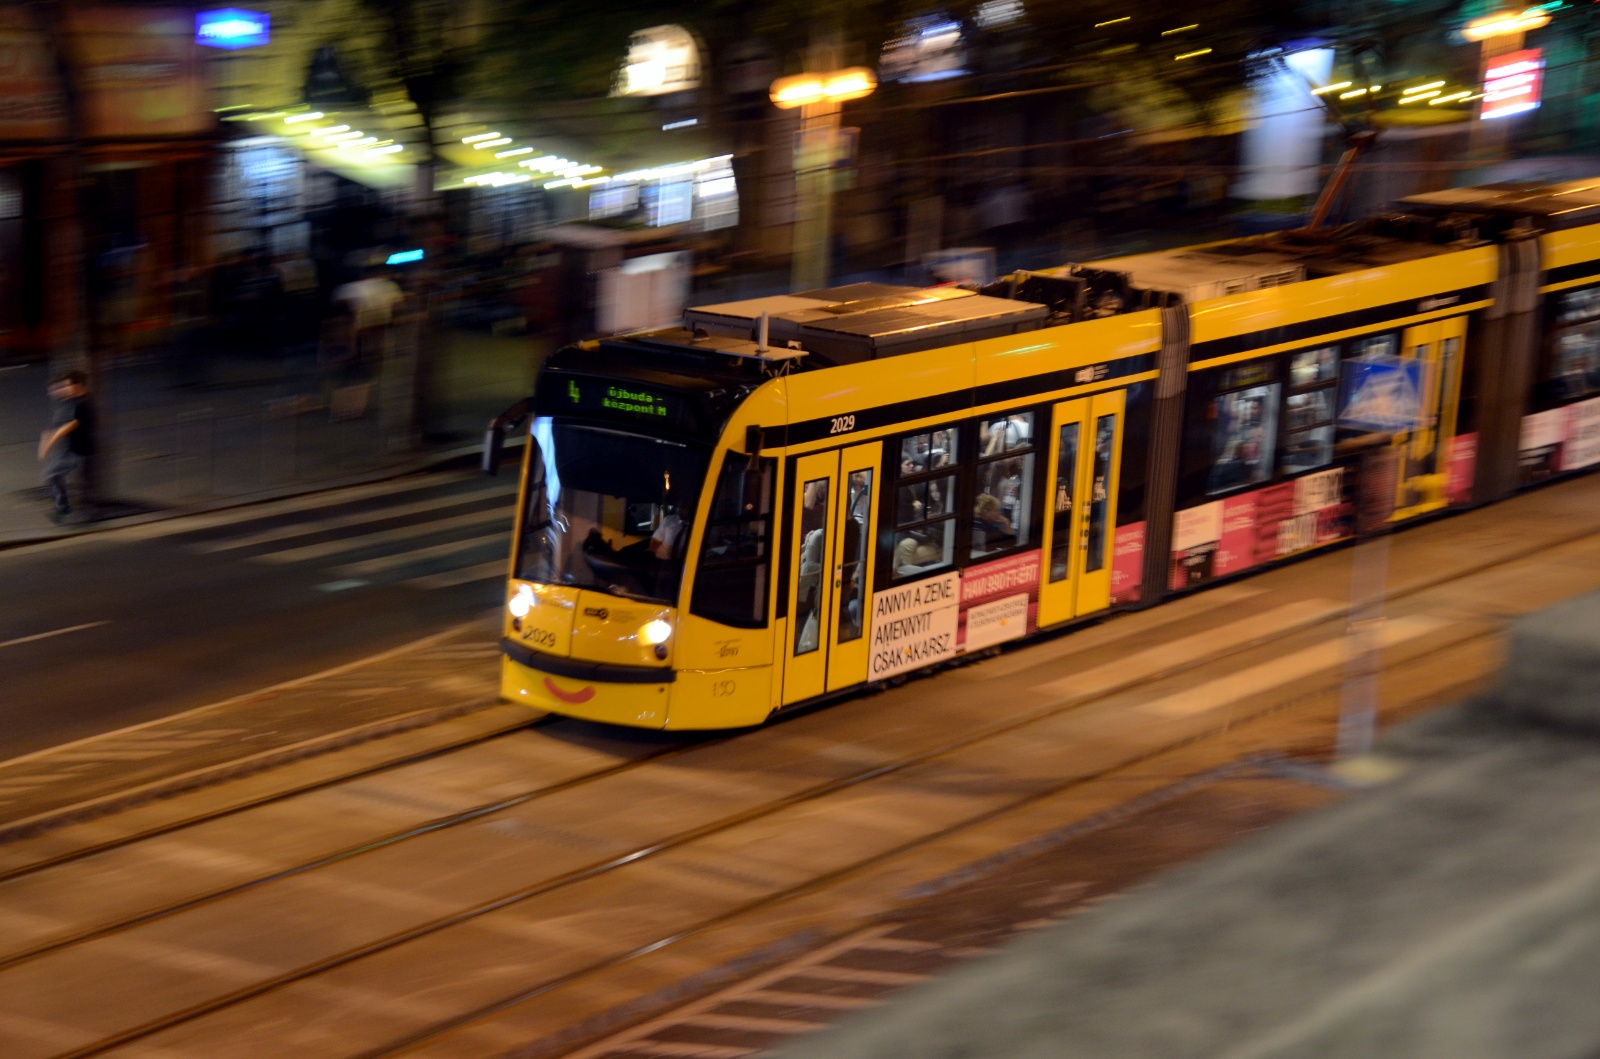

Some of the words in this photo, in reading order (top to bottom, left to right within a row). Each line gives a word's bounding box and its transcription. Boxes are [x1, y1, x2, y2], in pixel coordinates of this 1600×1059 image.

[830, 414, 856, 434] 2029
[876, 588, 912, 618] ANNYI
[913, 589, 922, 608] A
[924, 578, 955, 604] ZENE,
[522, 624, 556, 648] 2029
[874, 611, 933, 647] AMENNYIT
[873, 647, 905, 674] CSAK
